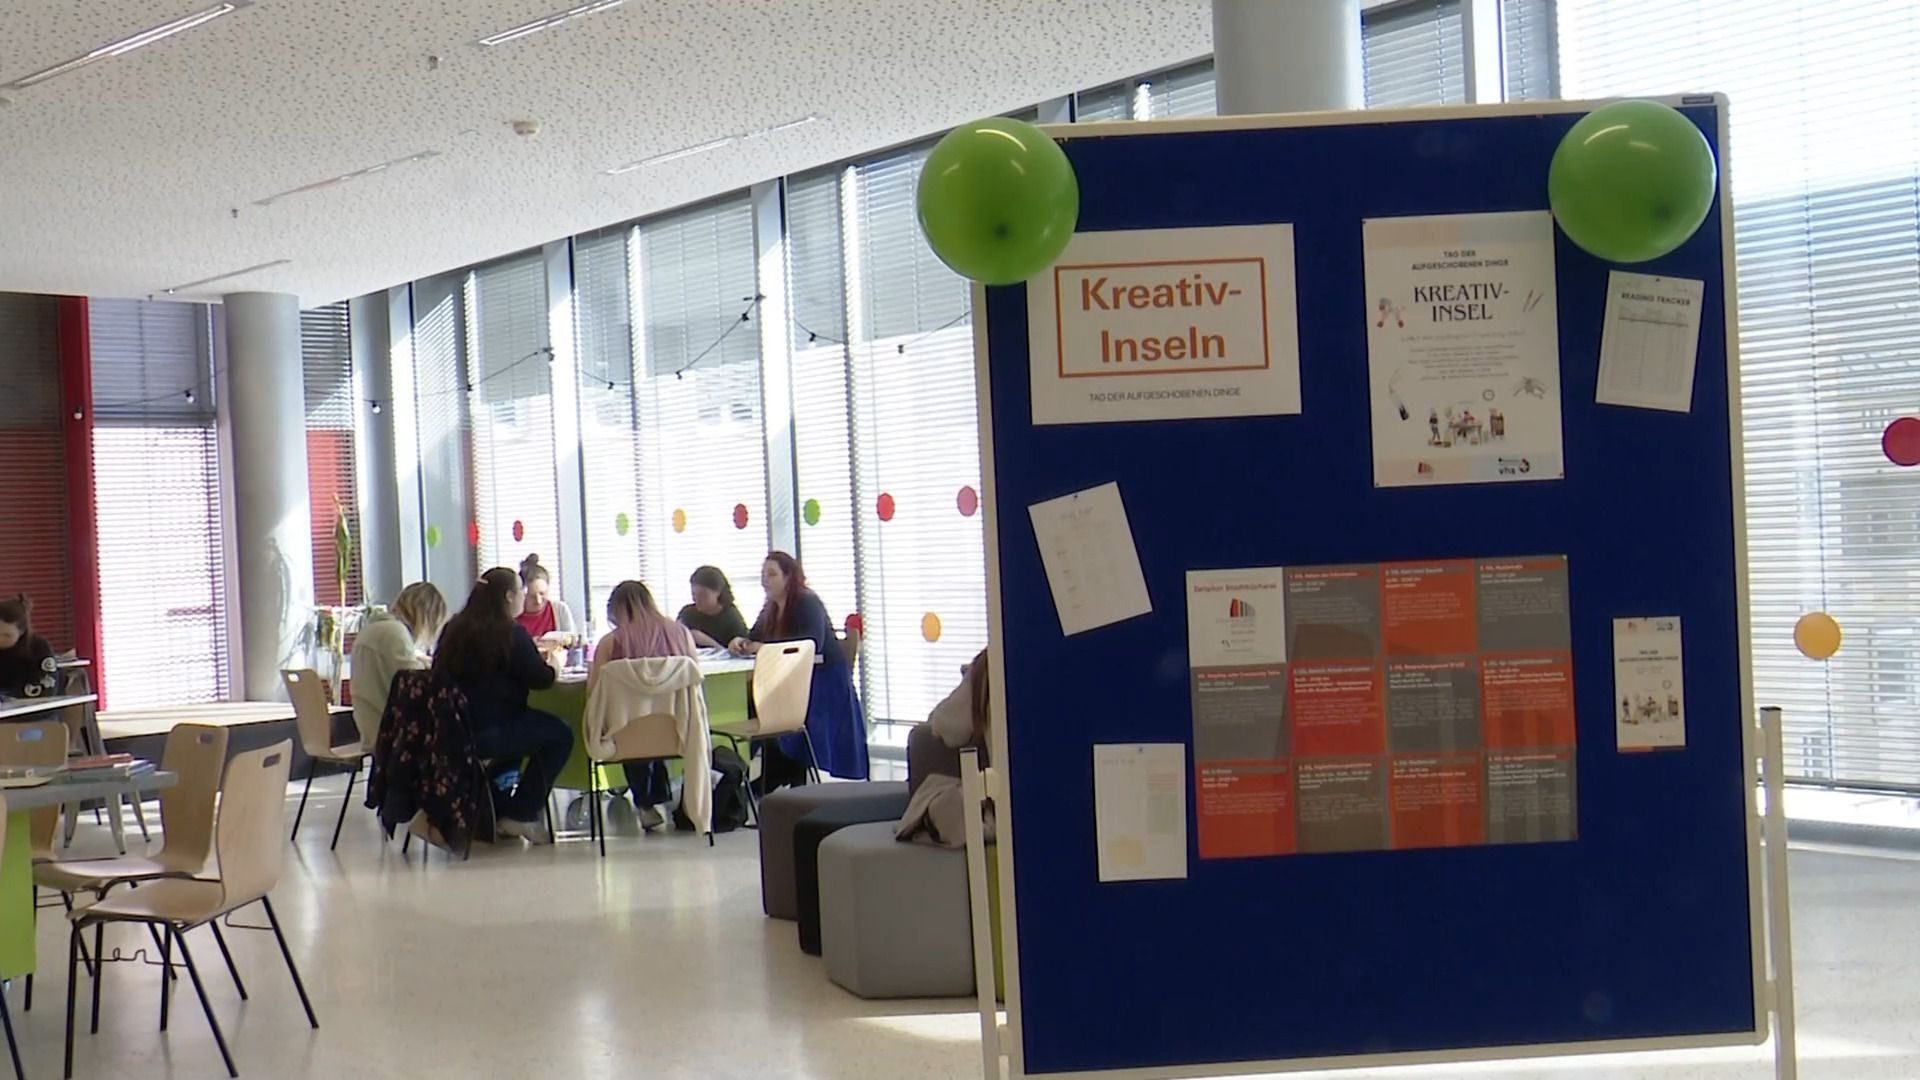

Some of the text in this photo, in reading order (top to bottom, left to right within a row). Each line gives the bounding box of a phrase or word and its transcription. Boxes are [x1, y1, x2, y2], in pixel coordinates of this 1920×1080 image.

[1081, 274, 1241, 311] Kreativ-
[1414, 282, 1509, 303] KREATIV-
[1432, 303, 1493, 322] INSEL
[1101, 326, 1225, 363] Inseln
[1089, 386, 1241, 402] TAG DER AUFGESCHOBENEN DINGE
